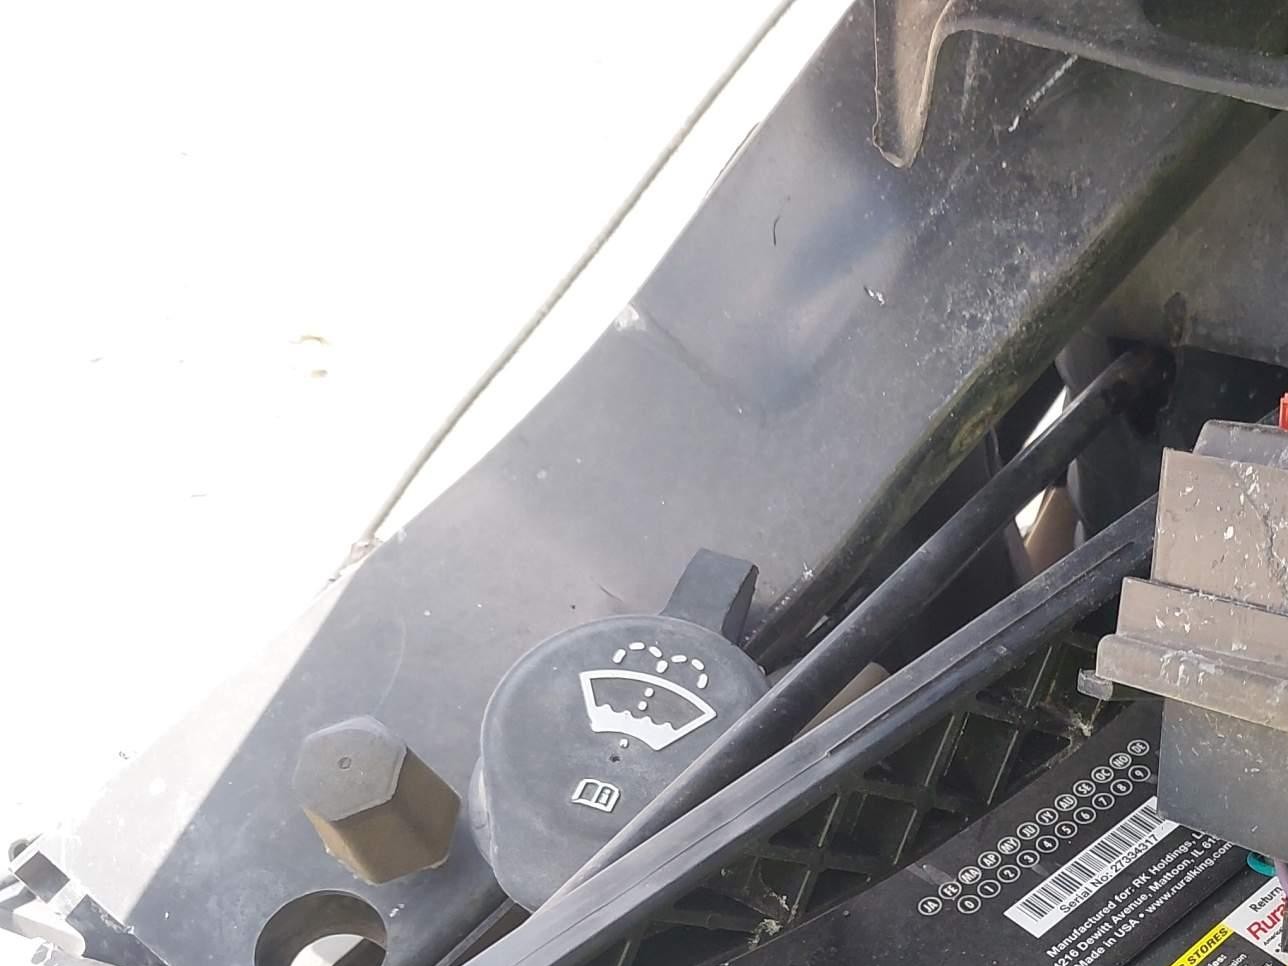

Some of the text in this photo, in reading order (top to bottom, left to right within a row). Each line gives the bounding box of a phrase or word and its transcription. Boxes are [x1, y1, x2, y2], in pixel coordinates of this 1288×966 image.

[1045, 900, 1117, 958] Manufactured
[1113, 886, 1135, 903] for:
[1131, 872, 1151, 888] RK
[1147, 840, 1196, 875] Holdings,
[1058, 833, 1163, 913] Serial No: 27334317
[1076, 921, 1113, 951] Dewitt
[1110, 892, 1152, 924] Avenue,
[1147, 858, 1195, 892] Mattoon,
[1189, 848, 1204, 858] IL
[1101, 937, 1117, 947] in
[1113, 918, 1140, 937] USA
[1144, 839, 1236, 913] www.ruralking.com
[1186, 927, 1228, 965] STORES
